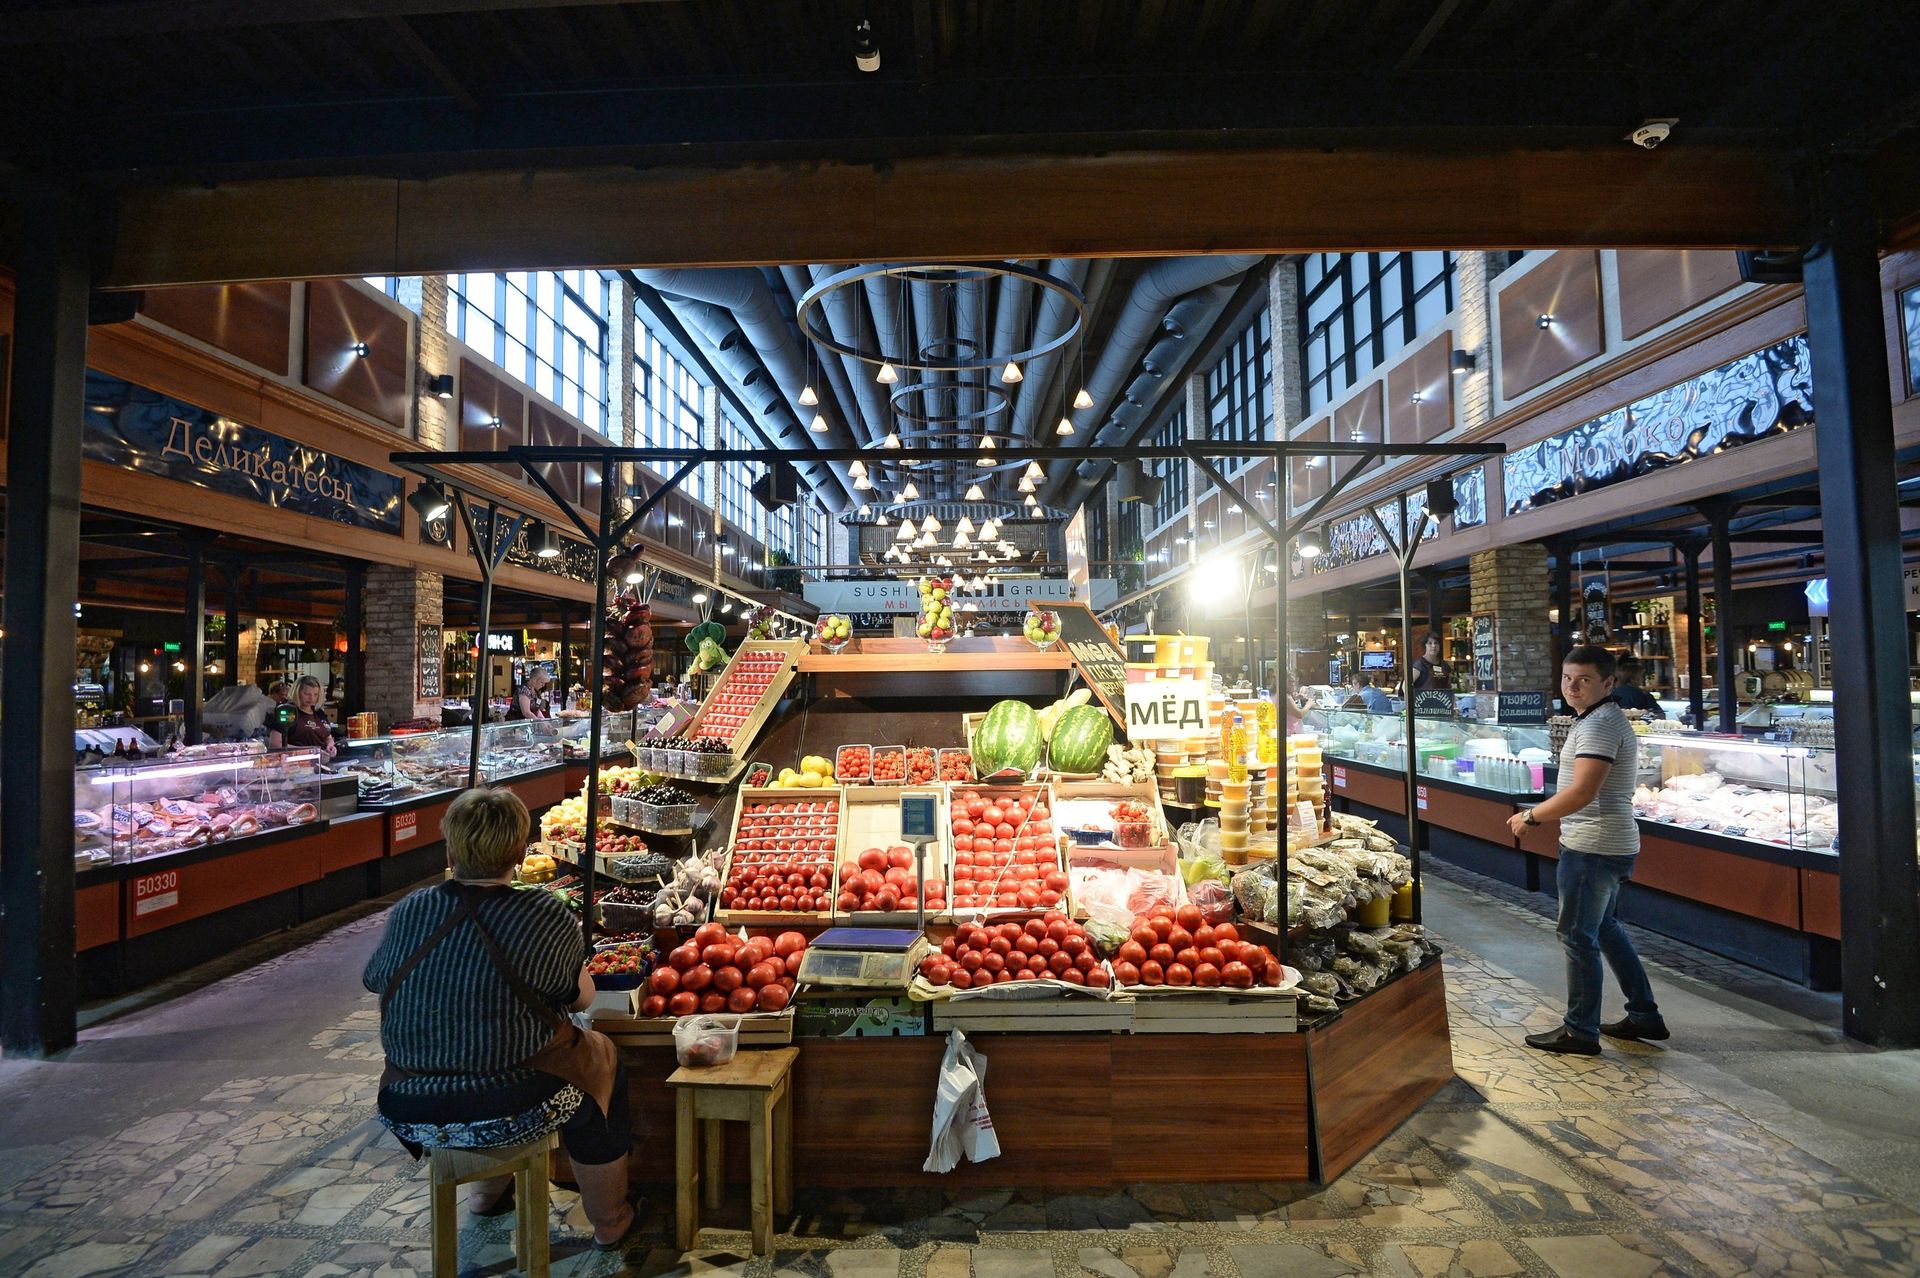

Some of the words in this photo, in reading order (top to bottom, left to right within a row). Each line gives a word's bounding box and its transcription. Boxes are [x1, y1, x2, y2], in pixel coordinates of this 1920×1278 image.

[161, 417, 352, 503] Деликатесы
[854, 587, 908, 597] SUSHI
[1011, 585, 1066, 596] GRILL
[885, 600, 908, 609] МЫ
[1131, 694, 1203, 729] МЁД
[137, 872, 177, 896] Б0330
